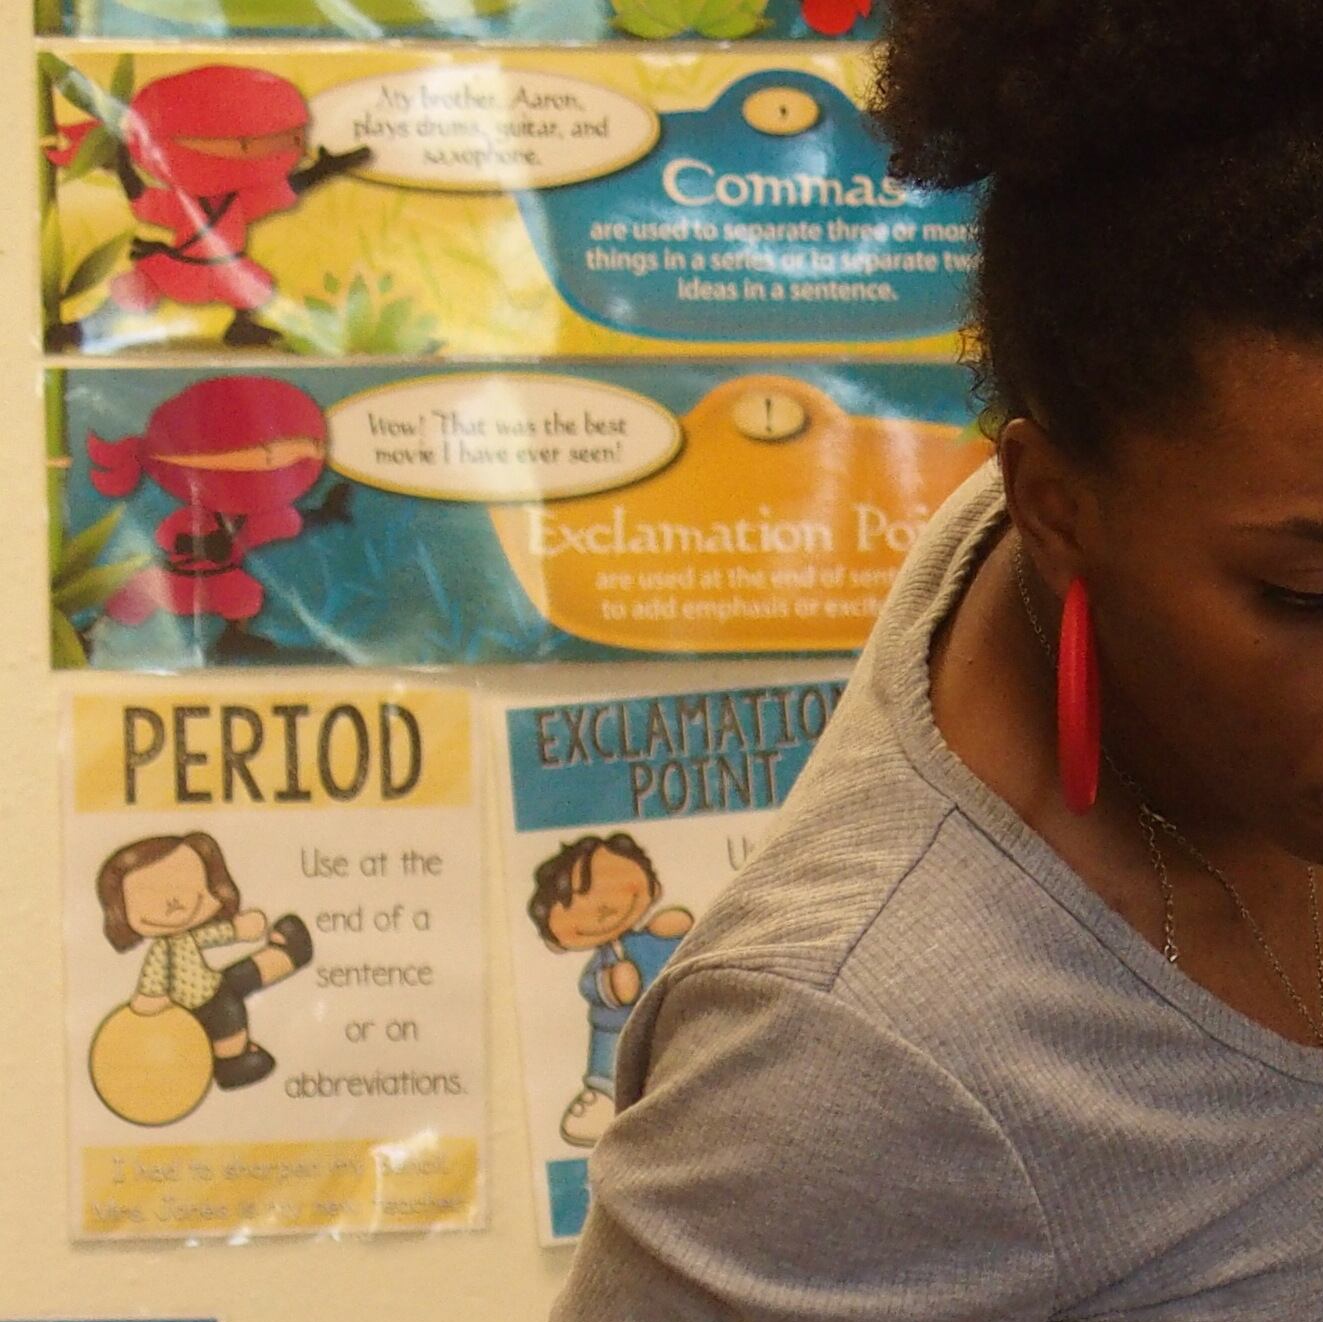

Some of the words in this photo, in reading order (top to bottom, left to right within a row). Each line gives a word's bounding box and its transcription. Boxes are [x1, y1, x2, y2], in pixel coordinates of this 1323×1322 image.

[661, 158, 906, 207] Commas
[590, 224, 627, 241] are
[633, 219, 689, 241] used
[691, 221, 718, 241] to
[723, 222, 821, 248] separate
[827, 219, 887, 241] three
[892, 223, 916, 241] or
[922, 223, 979, 241] mor
[585, 248, 659, 275] things
[664, 250, 686, 271] in
[690, 255, 702, 271] a
[710, 252, 776, 273] series
[781, 255, 805, 273] or
[810, 252, 835, 273] to
[840, 253, 938, 277] separate
[676, 277, 738, 301] ideas
[744, 278, 766, 301] in
[771, 284, 783, 301] a
[789, 281, 899, 301] sentence.
[368, 412, 424, 437] Wow!
[431, 410, 486, 437] That
[496, 419, 537, 437] was
[544, 411, 578, 437] the
[584, 412, 627, 437] best
[375, 442, 435, 465] movie
[459, 443, 503, 465] have
[516, 447, 560, 465] ever
[568, 442, 624, 465] seen!
[527, 502, 836, 556] Exclamation
[597, 573, 631, 590] are
[639, 567, 695, 590] used
[700, 571, 724, 590] at
[728, 567, 765, 590] the
[771, 567, 816, 590] end
[820, 566, 845, 589] of
[123, 702, 425, 806] PERIOD
[630, 750, 782, 819] POINT
[300, 848, 347, 879] Use
[360, 853, 389, 878] at
[400, 847, 443, 877] the
[315, 905, 362, 934] end
[373, 903, 405, 933] of
[412, 909, 431, 932] a
[315, 961, 434, 990] sentence
[344, 1017, 377, 1043] or
[385, 1016, 418, 1042] an
[282, 1070, 469, 1100] abbreviations.
